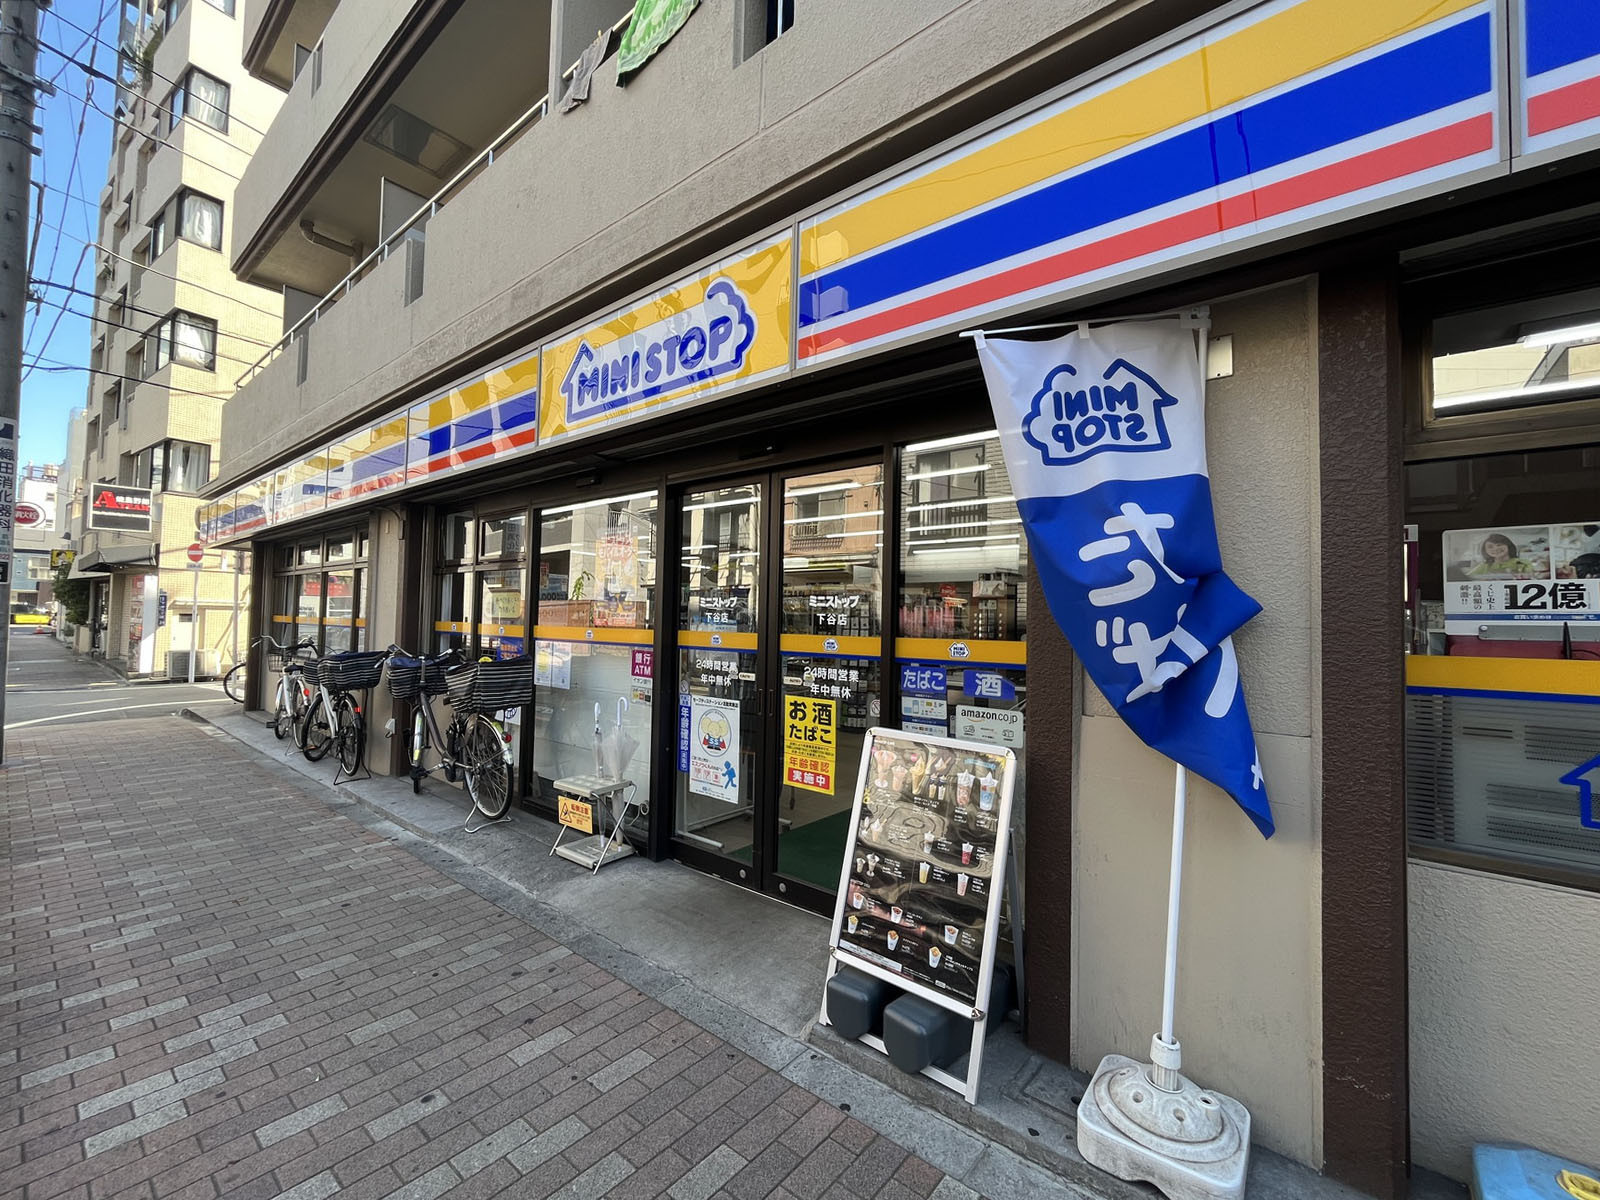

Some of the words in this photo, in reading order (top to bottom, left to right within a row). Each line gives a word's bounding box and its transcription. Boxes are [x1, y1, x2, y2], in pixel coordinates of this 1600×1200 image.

[577, 350, 641, 407] MINI
[644, 315, 733, 383] STOP
[699, 596, 738, 608] ミニストップ
[808, 595, 861, 608] ミニストップ
[1504, 582, 1588, 610] 12億
[705, 612, 730, 623] 下谷店
[816, 613, 848, 626] 下谷店
[635, 652, 651, 665] 銀行
[695, 659, 739, 672] 24時間営業
[634, 665, 651, 676] ATM
[803, 667, 860, 683] 24時間営業
[700, 674, 732, 686] 年中無休
[903, 669, 945, 690] たばこ
[974, 673, 1003, 697] 酒
[810, 683, 852, 699] 年中無休
[789, 700, 833, 726] お酒
[789, 724, 833, 744] たばこ
[789, 756, 831, 774] 年齢確認
[792, 769, 827, 787] 実施中
